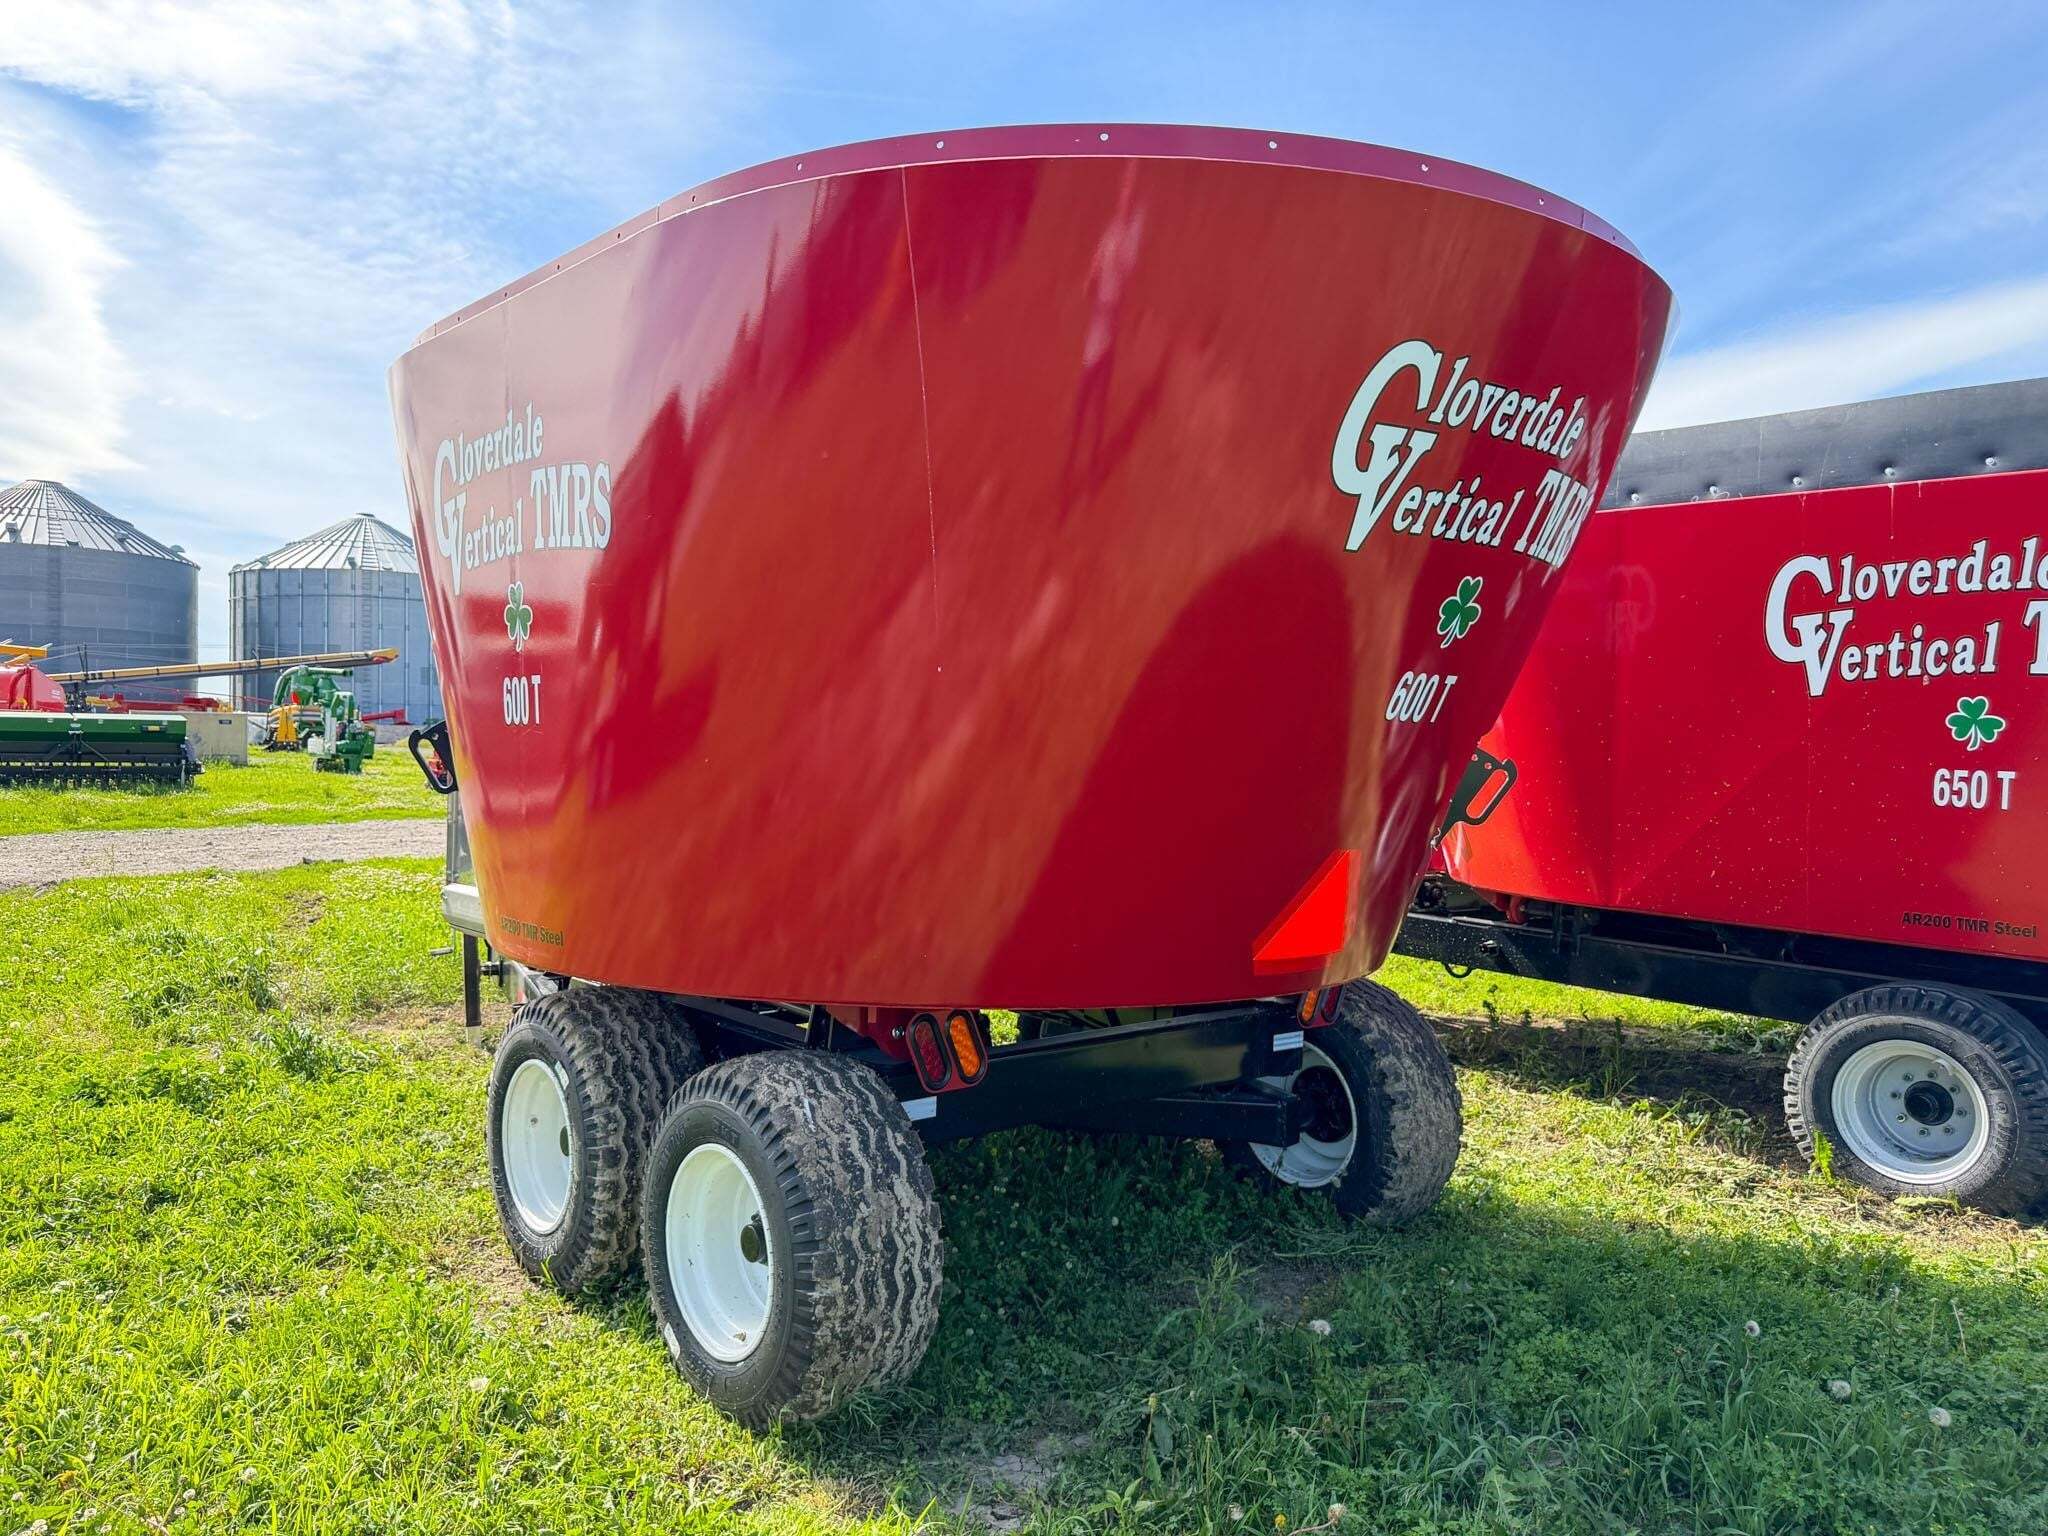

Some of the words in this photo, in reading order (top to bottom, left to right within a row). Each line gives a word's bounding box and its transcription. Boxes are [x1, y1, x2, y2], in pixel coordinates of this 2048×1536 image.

[1331, 338, 1585, 495] Cloverdale
[433, 401, 544, 558] Cloverdale
[1344, 423, 1525, 552] Vertical
[443, 491, 523, 596] Vertical
[530, 459, 613, 551] TMRS
[1791, 607, 2001, 698] Vertical
[503, 676, 530, 727] 600
[531, 674, 542, 726] T
[1385, 670, 1437, 723] 600
[1430, 674, 1458, 723] T
[1932, 768, 1988, 809] 650
[1997, 770, 2017, 811] T
[540, 926, 564, 947] Steel
[1902, 912, 1951, 929] AR200
[1956, 917, 1989, 933] TMR
[1994, 921, 2038, 938] Steel
